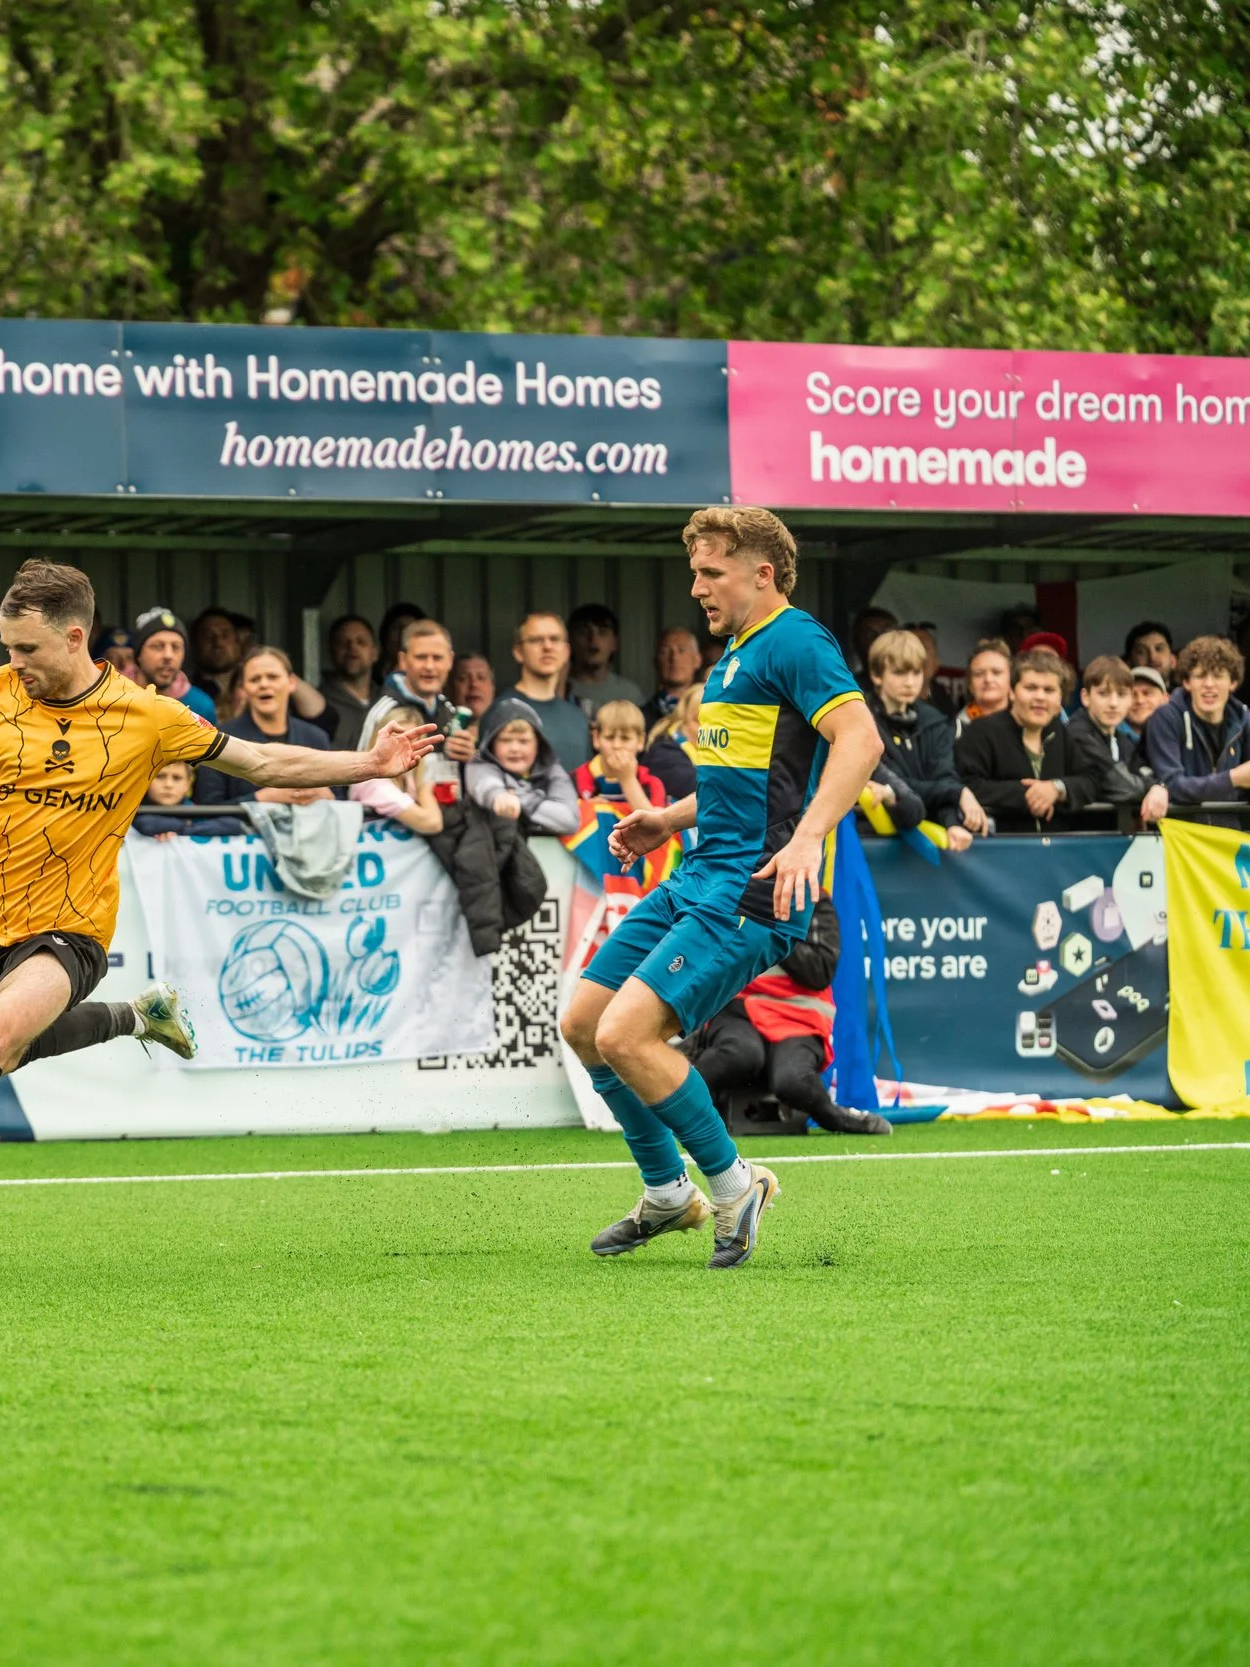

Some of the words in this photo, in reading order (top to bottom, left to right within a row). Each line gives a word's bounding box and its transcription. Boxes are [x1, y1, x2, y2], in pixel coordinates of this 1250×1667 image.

[134, 354, 232, 398] with
[247, 355, 503, 405] Homemade
[517, 362, 661, 409] Homes
[806, 371, 921, 417] Score
[934, 388, 1024, 428] your
[1036, 380, 1162, 422] dream
[220, 422, 667, 474] homemadehomes.com
[810, 431, 1086, 487] homemade
[24, 788, 123, 813] GEMINI
[223, 852, 385, 892] UND
[206, 898, 330, 916] FOOTBALL
[340, 894, 400, 914] CLUB
[921, 916, 987, 948] your
[941, 955, 987, 979] are
[235, 1046, 285, 1062] THE
[297, 1040, 383, 1062] TULIPS
